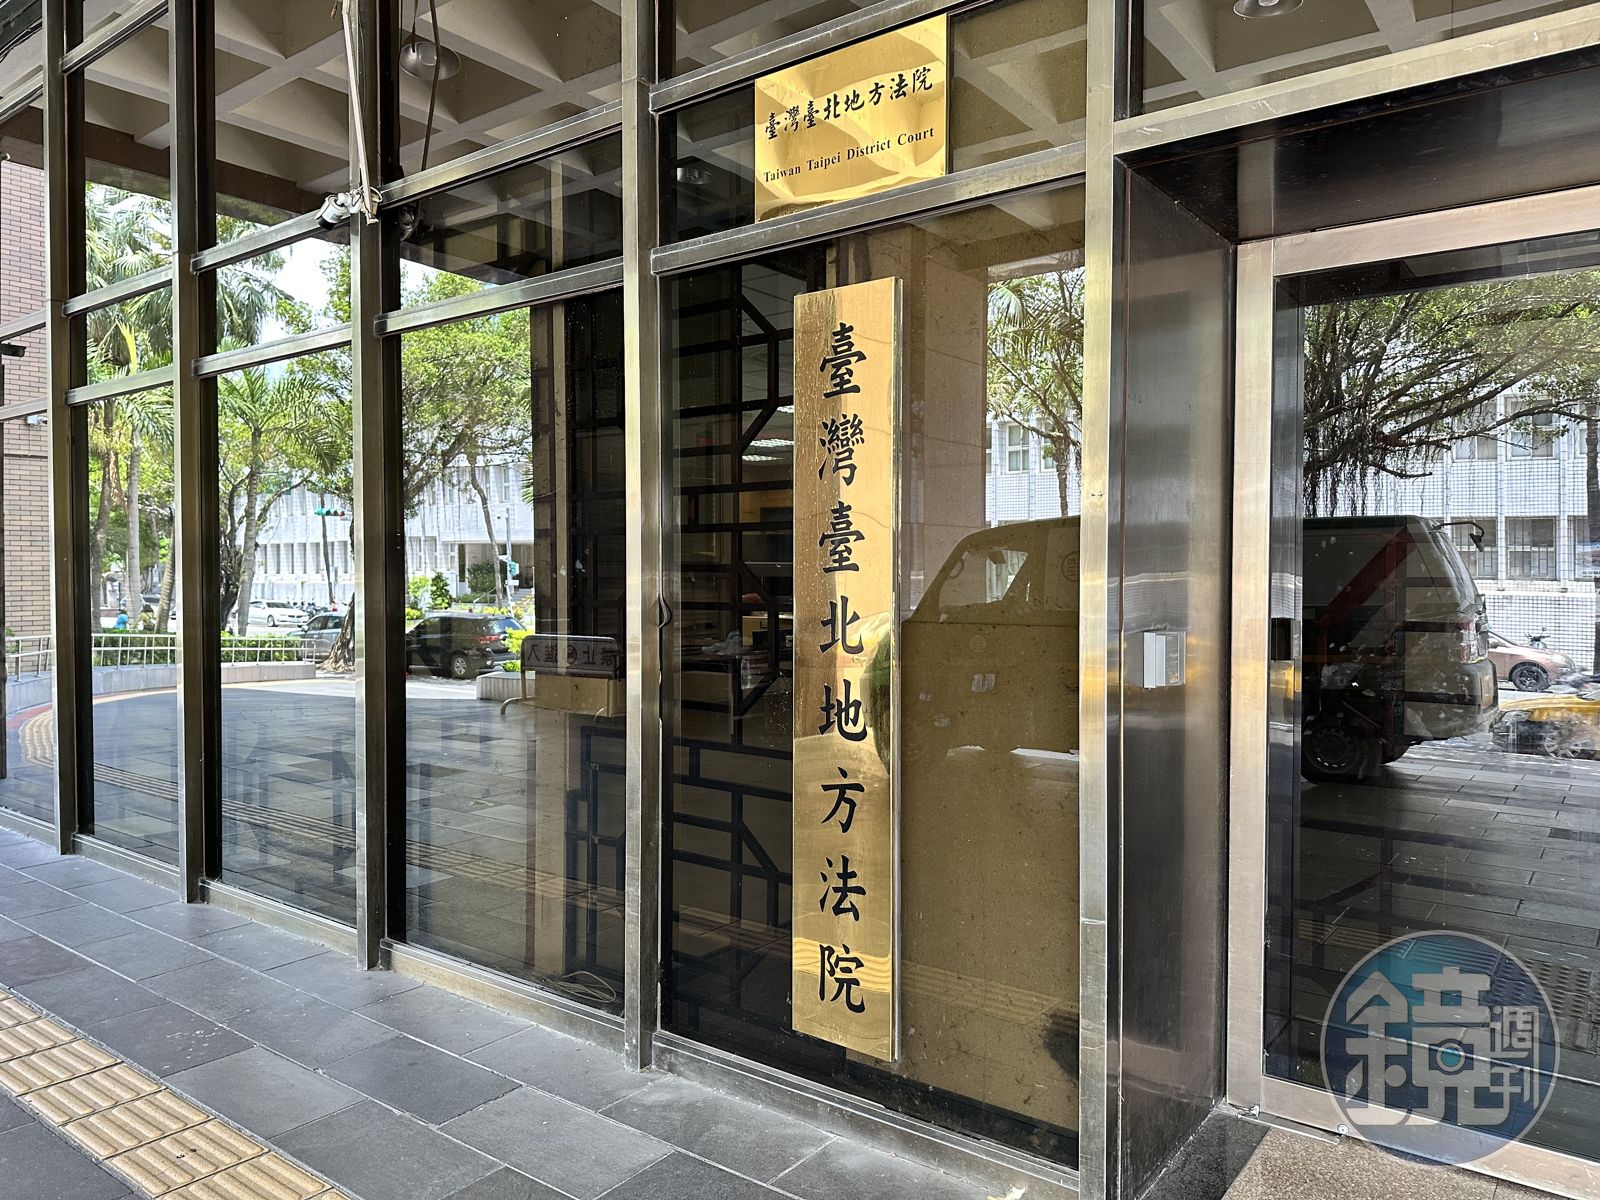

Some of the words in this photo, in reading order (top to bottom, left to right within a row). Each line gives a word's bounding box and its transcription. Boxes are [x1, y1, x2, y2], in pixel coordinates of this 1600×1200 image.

[765, 67, 933, 140] 臺灣臺北地方法院
[763, 166, 801, 183] Taiwan
[806, 152, 842, 171] Taipei
[846, 139, 891, 160] District
[897, 127, 935, 146] Court
[818, 321, 867, 1014] 臺灣臺北地方法院
